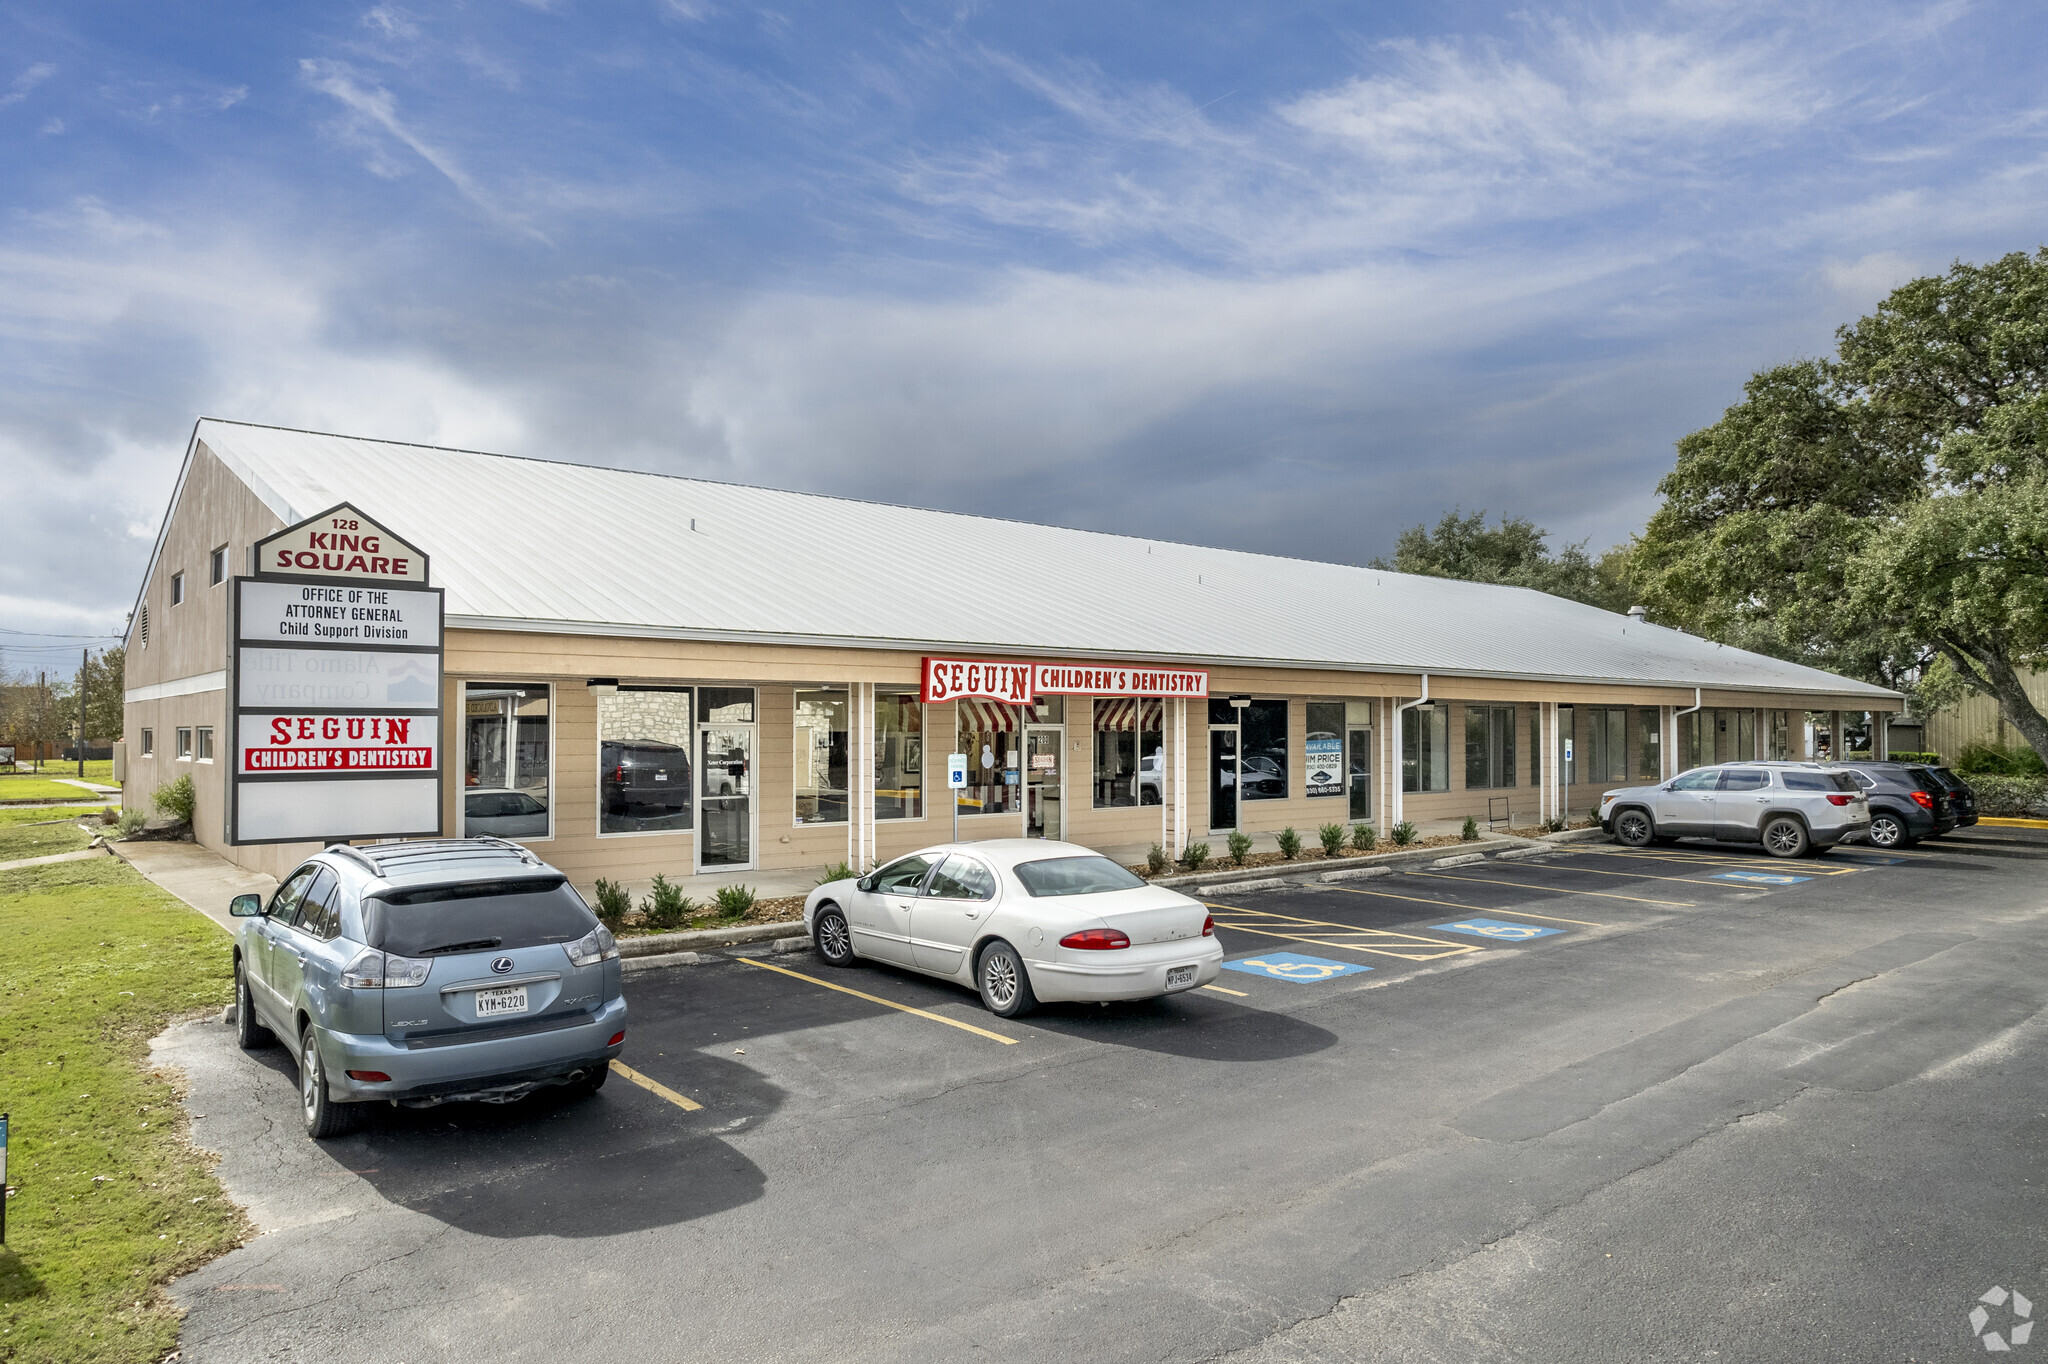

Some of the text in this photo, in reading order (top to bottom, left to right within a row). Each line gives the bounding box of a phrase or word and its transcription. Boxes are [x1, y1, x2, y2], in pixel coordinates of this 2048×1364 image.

[332, 518, 359, 531] 128
[309, 531, 380, 554] KING
[276, 550, 409, 576] SQUARE
[302, 587, 389, 605] OFFICE OF THE
[285, 604, 403, 622] ATTORNEY GENERAL
[279, 621, 409, 640] Child Support Division
[932, 663, 1029, 700] SEGUIN
[1040, 668, 1203, 692] CHILDREN'S DENTISTRY
[270, 716, 411, 746] SEGUIN
[1306, 742, 1340, 751] AVAILABLE
[251, 750, 427, 768] CHILDREN'S DENTISTRY
[1317, 753, 1340, 763] PRICE
